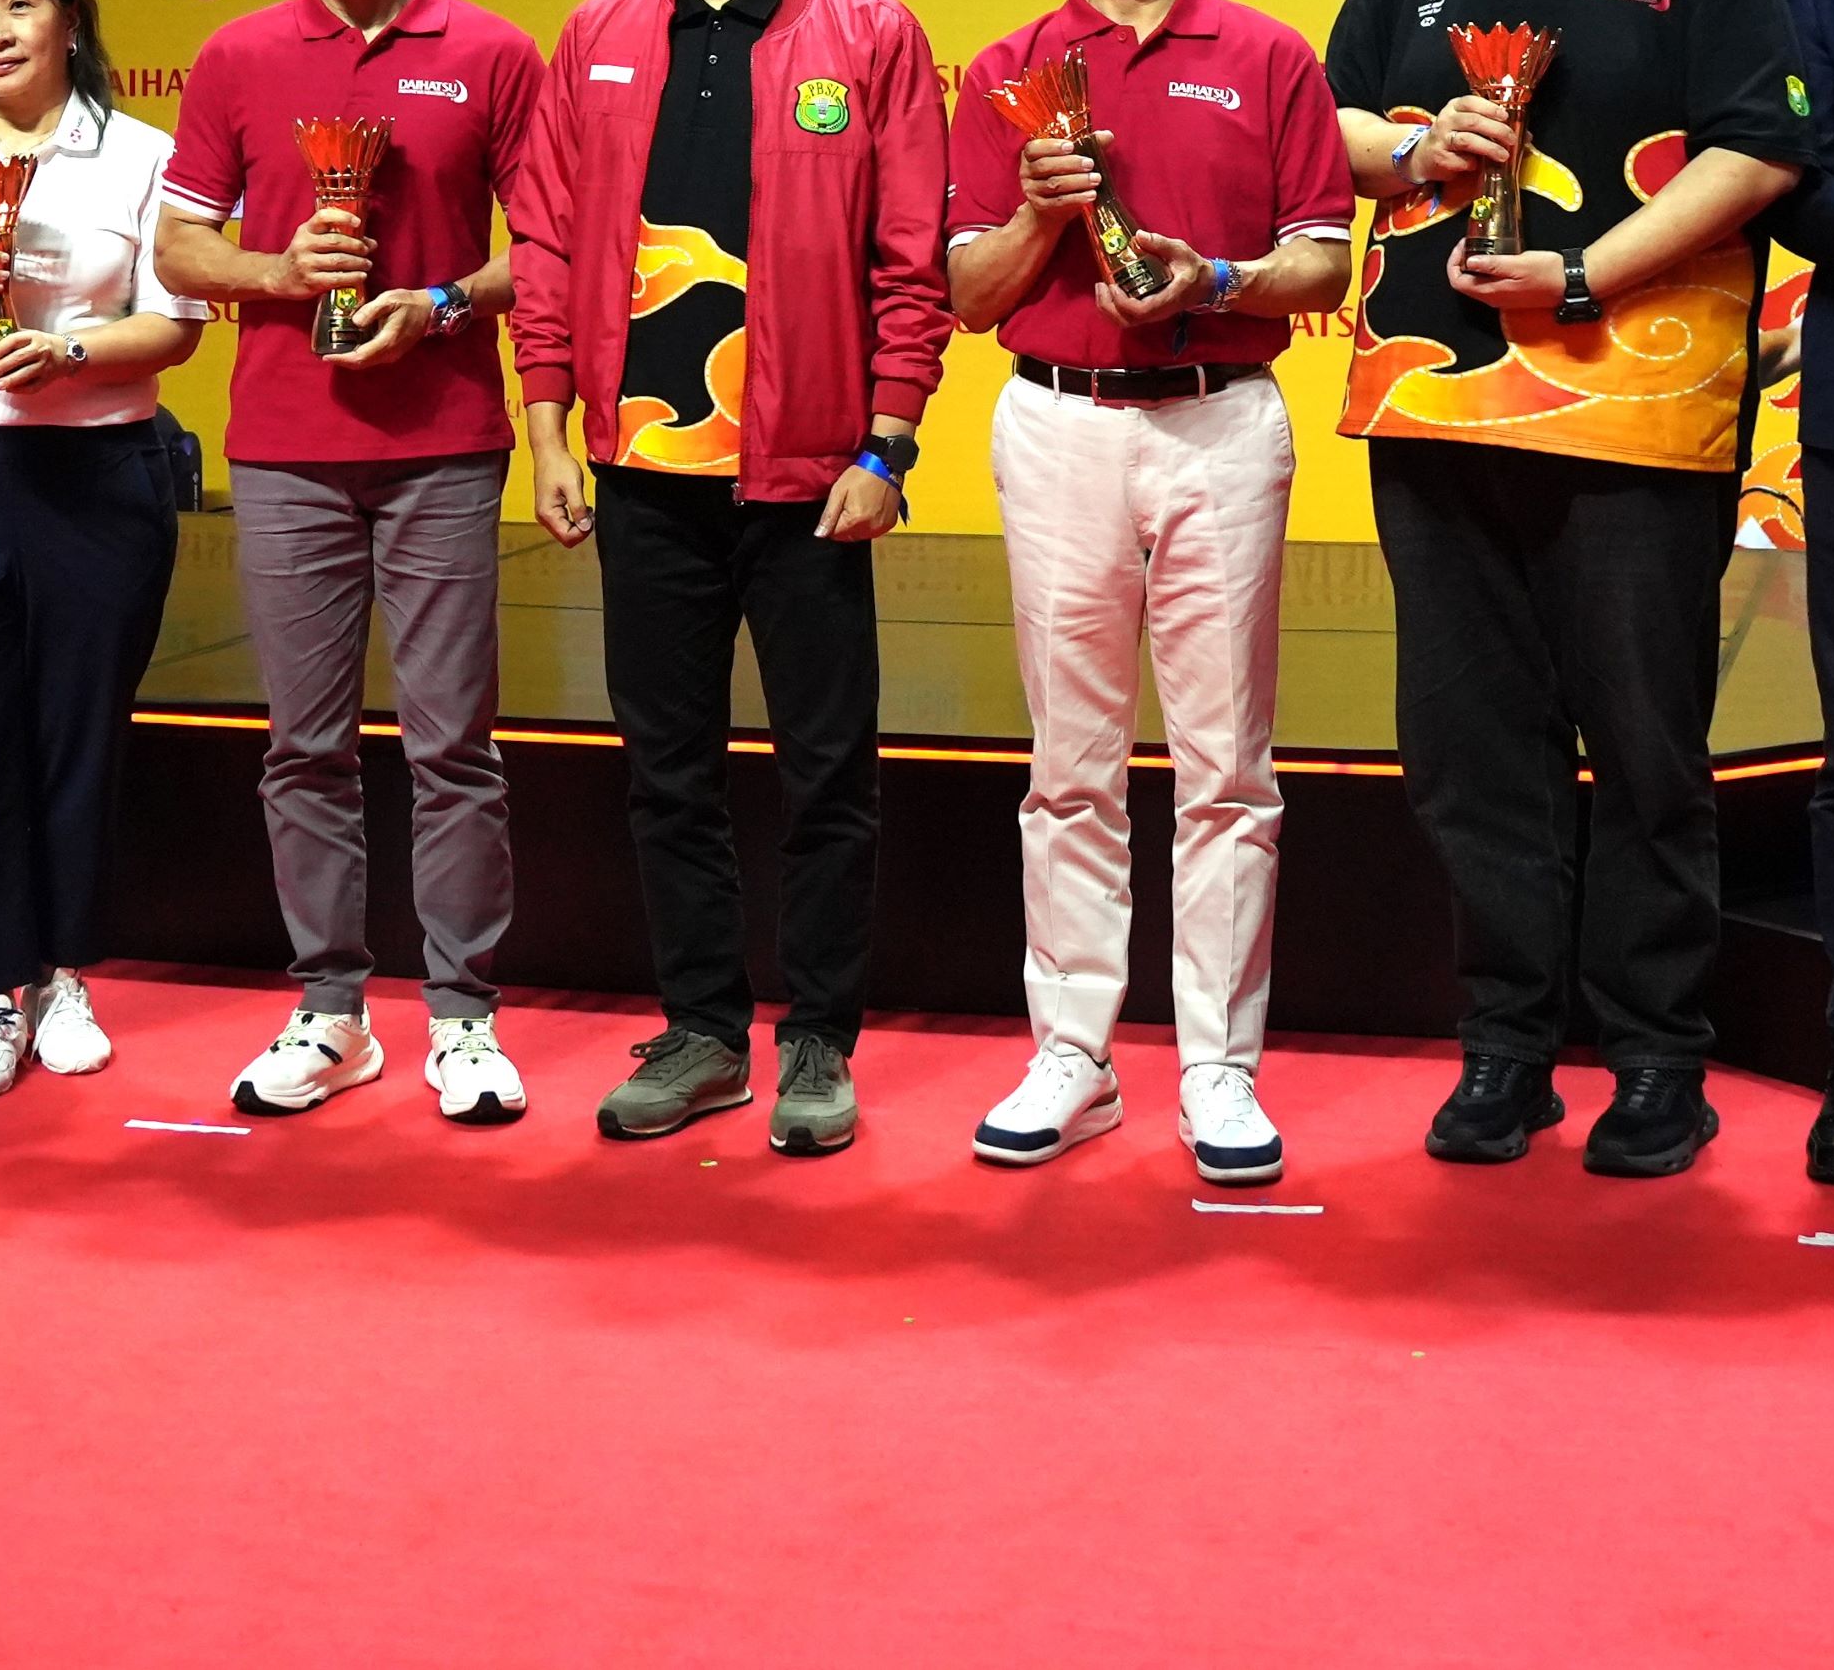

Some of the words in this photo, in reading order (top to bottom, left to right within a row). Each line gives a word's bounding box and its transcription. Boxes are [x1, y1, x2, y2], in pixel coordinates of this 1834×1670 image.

[398, 78, 458, 95] DAIHATSU
[807, 82, 839, 99] PBSI
[1168, 81, 1230, 101] DAIHATSU
